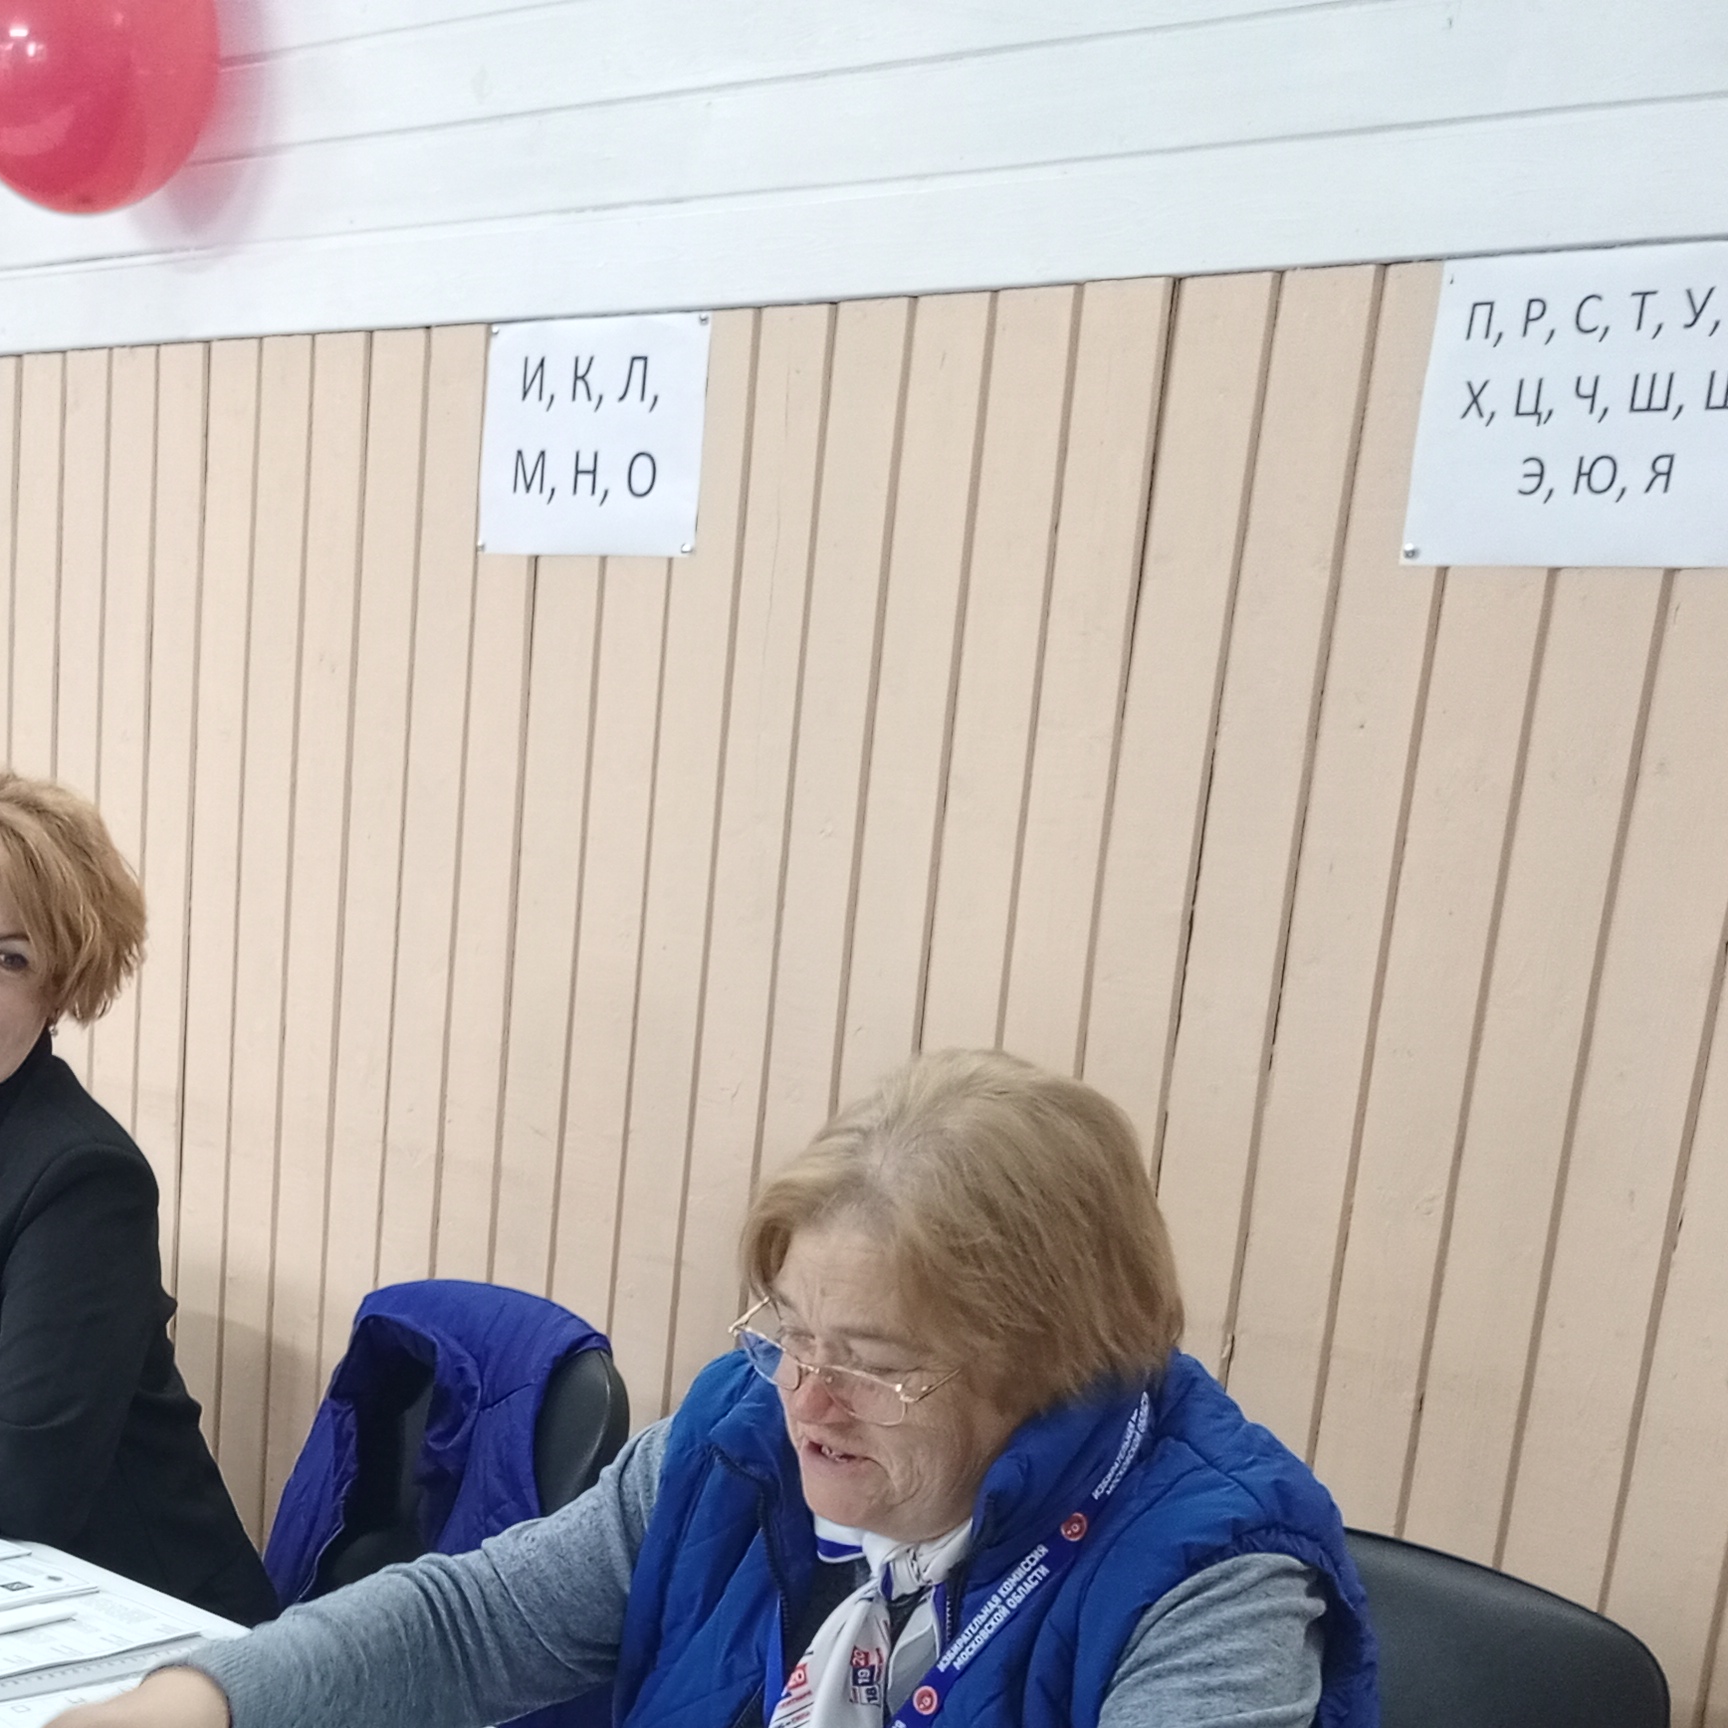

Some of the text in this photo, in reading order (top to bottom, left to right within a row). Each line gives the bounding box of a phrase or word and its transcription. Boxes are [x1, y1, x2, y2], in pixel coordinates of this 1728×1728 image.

[1465, 286, 1721, 348] П, Р, С, Т, У,
[522, 356, 658, 413] И, К, Л,
[1461, 379, 1496, 427] Х,
[1514, 377, 1554, 427] Ц,
[1575, 374, 1610, 423] Ч,
[1628, 371, 1684, 420] Ш,
[513, 450, 657, 507] М, Н, О
[1518, 453, 1675, 504] Э, Ю, Я
[934, 1541, 1049, 1673] ИЗБИРАТЕЛЬНАЯ КОМИССИЯ
[950, 1562, 1051, 1671] МОСКОВСКОЙ ОБЛАСТИ
